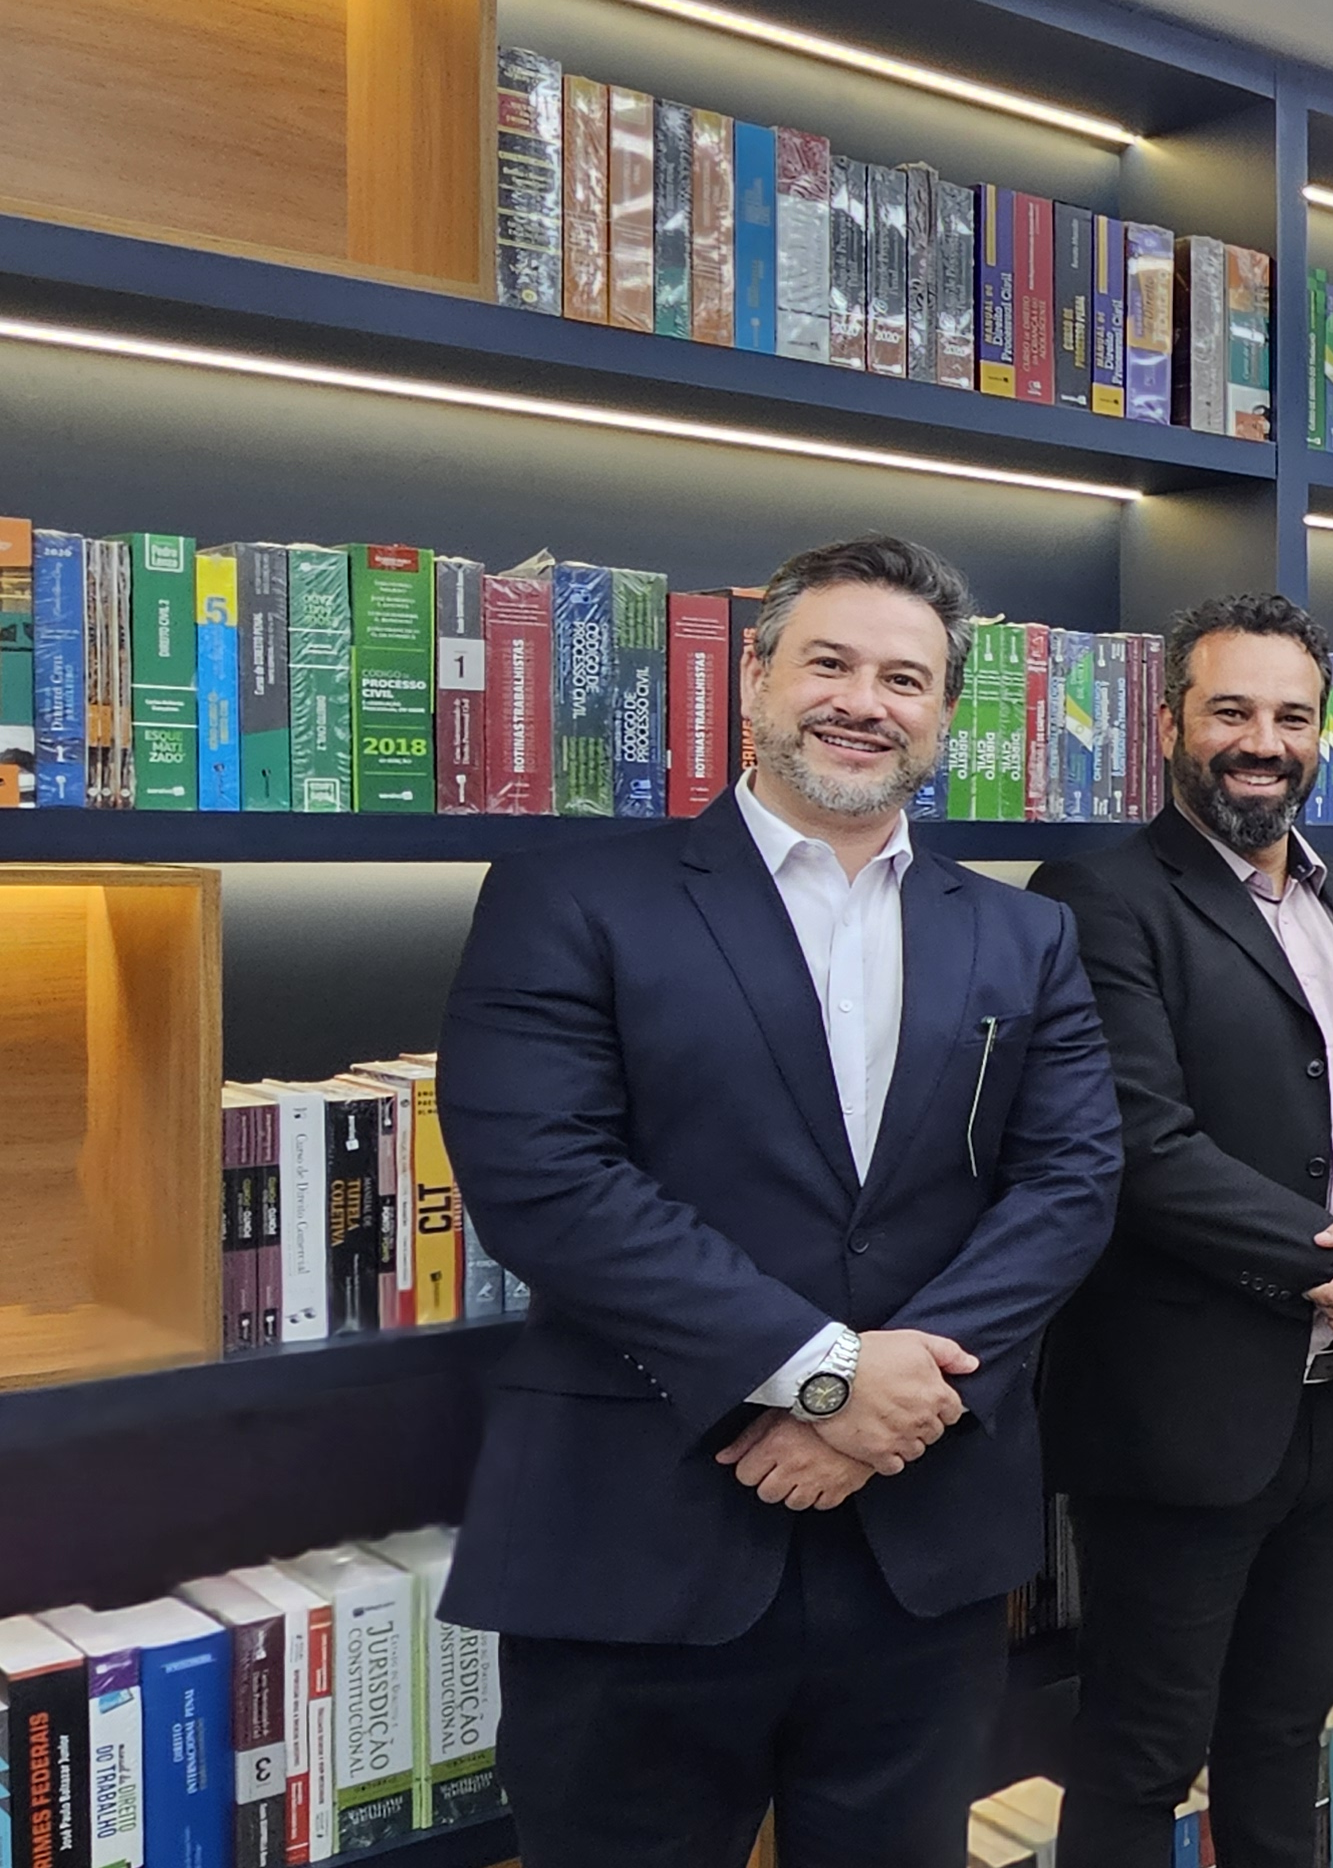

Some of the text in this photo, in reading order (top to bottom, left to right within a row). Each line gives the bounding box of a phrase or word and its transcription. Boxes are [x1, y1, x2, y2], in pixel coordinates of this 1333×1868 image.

[1000, 272, 1012, 301] Civil
[992, 306, 1004, 347] Direito
[1038, 299, 1047, 359] ADOLESCENTE
[1111, 299, 1123, 326] Civil
[1104, 331, 1114, 370] Direito
[158, 606, 169, 626] CIVIL
[204, 596, 229, 625] 5
[158, 626, 169, 657] DIREITO
[585, 622, 600, 693] CÓDIGO DE
[361, 678, 427, 691] PROCESSO
[453, 655, 464, 678] 1
[571, 621, 586, 719] PROCESSO CIVIL
[362, 688, 395, 699] CIVIL
[512, 639, 525, 773] ROTINAS TRABALHISTAS
[636, 666, 650, 763] PROCESSO CIVIL
[694, 651, 706, 778] ROTINAS TRABALHISTAS
[144, 729, 183, 741] ESQUE
[363, 737, 427, 757] 2018
[624, 691, 637, 762] CÓDIGO DE
[148, 751, 183, 764] ZADO
[949, 738, 958, 772] CIVIL
[957, 730, 968, 780] DIREITO
[976, 739, 986, 773] CIVIL
[985, 731, 996, 781] DIREITO
[1002, 740, 1012, 773] CIVIL
[1010, 733, 1021, 782] DIREITO
[295, 1133, 308, 1164] Curso
[296, 1182, 309, 1219] Direito
[330, 1179, 346, 1247] COLETIVA
[346, 1177, 361, 1232] TUTELA
[362, 1177, 372, 1213] MANUAL
[417, 1184, 452, 1235] CLT
[296, 1221, 310, 1275] Comercial
[347, 1627, 364, 1778] CONSTITUCIONAL
[363, 1620, 394, 1771] JURISDIÇÃO
[439, 1623, 456, 1755] ONSTITUCIONAL
[455, 1627, 484, 1746] RISDIÇÃO
[172, 1723, 184, 1763] DIREITO
[184, 1688, 199, 1795] INTERNACIONAL PENAL
[29, 1711, 54, 1868] RIMES FEDERAIS
[95, 1744, 118, 1839] DO TRABALHO
[255, 1756, 272, 1782] 3
[59, 1803, 71, 1829] Paulo
[117, 1784, 136, 1833] DIREITO
